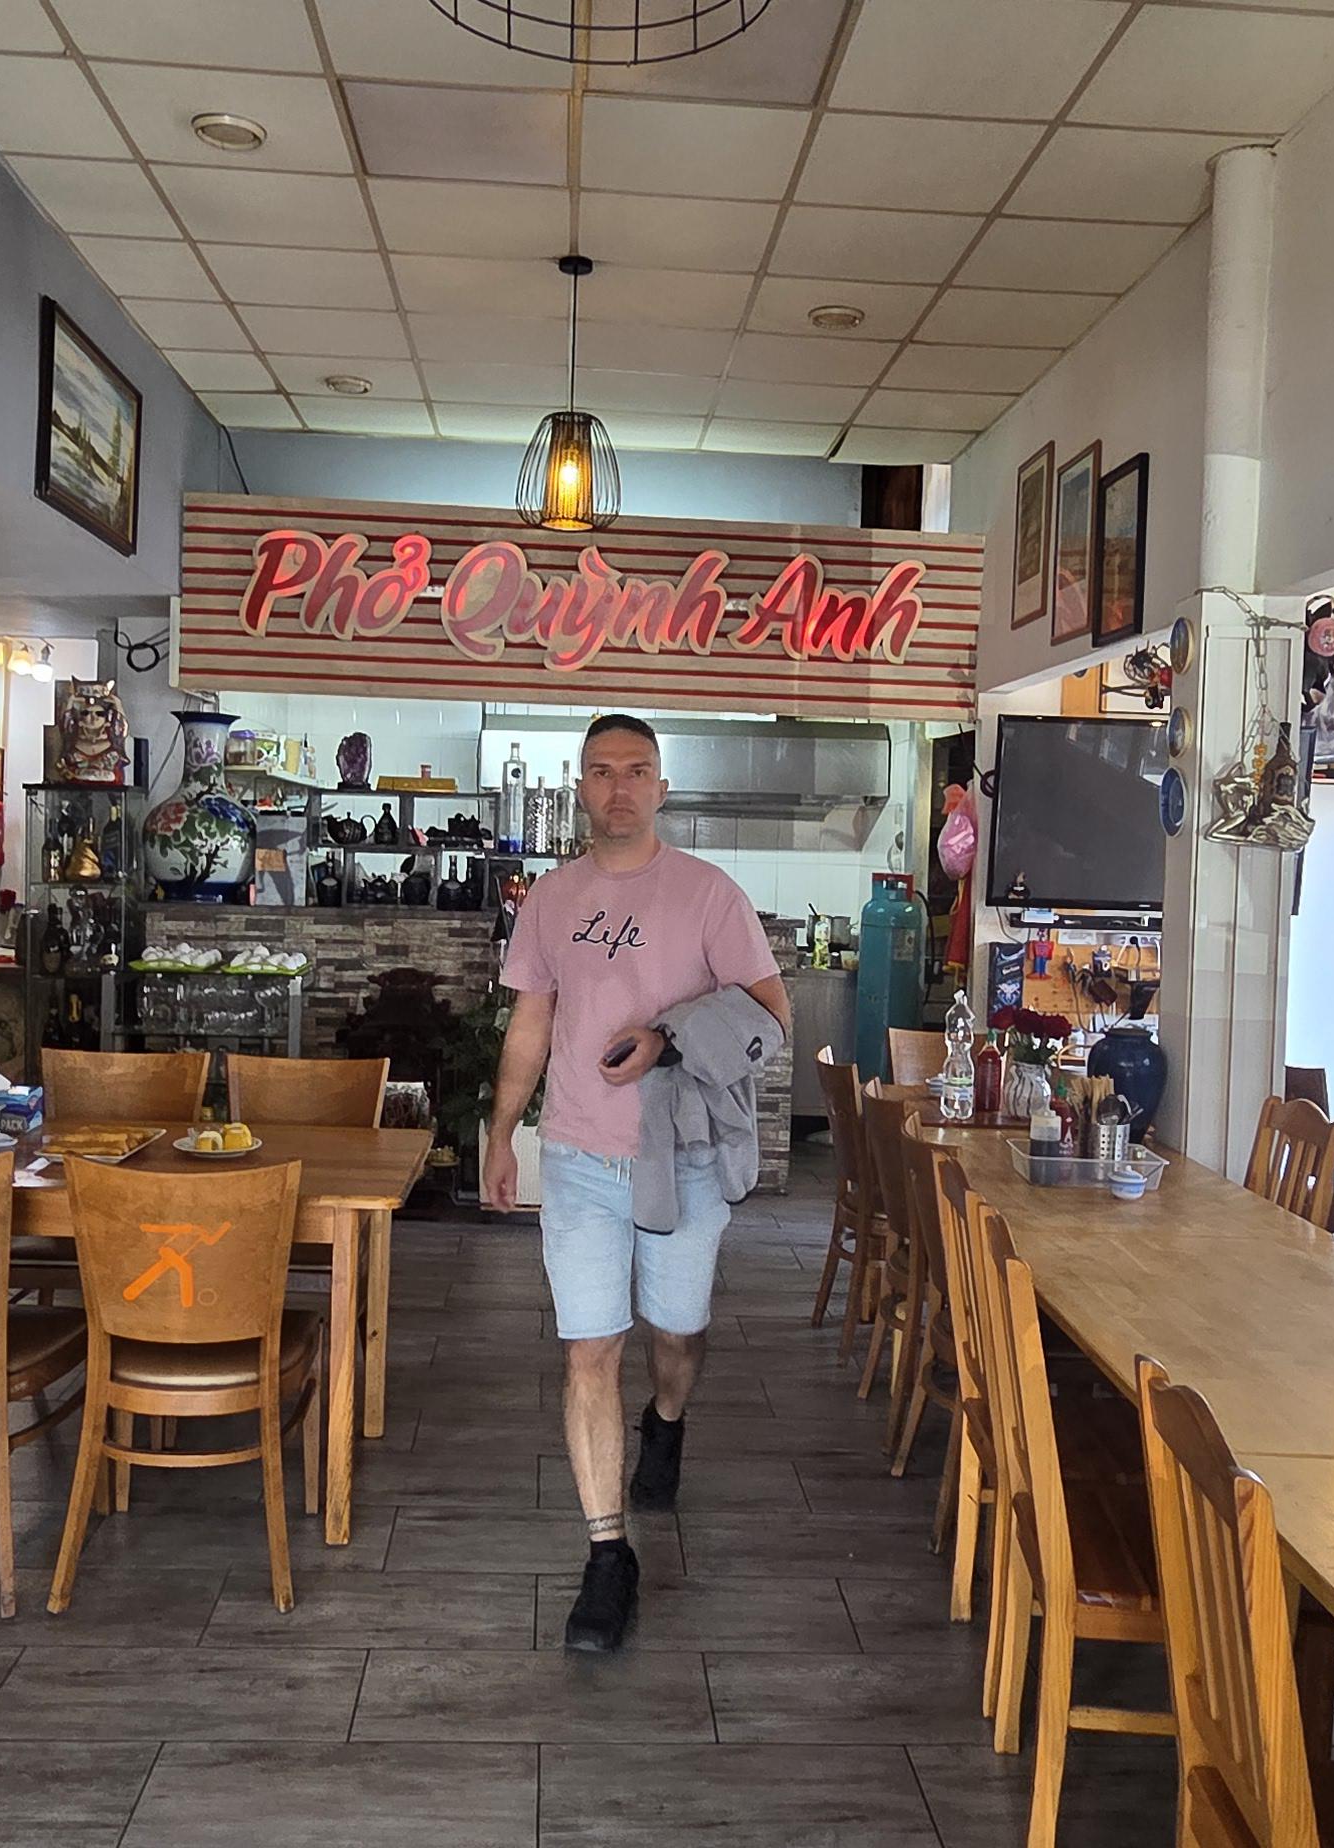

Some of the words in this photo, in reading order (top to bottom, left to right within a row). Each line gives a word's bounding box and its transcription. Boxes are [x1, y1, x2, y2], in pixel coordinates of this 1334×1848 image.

[238, 529, 433, 642] Phở
[441, 541, 731, 672] Quỳnh
[728, 552, 927, 665] Anh
[571, 910, 647, 960] Life
